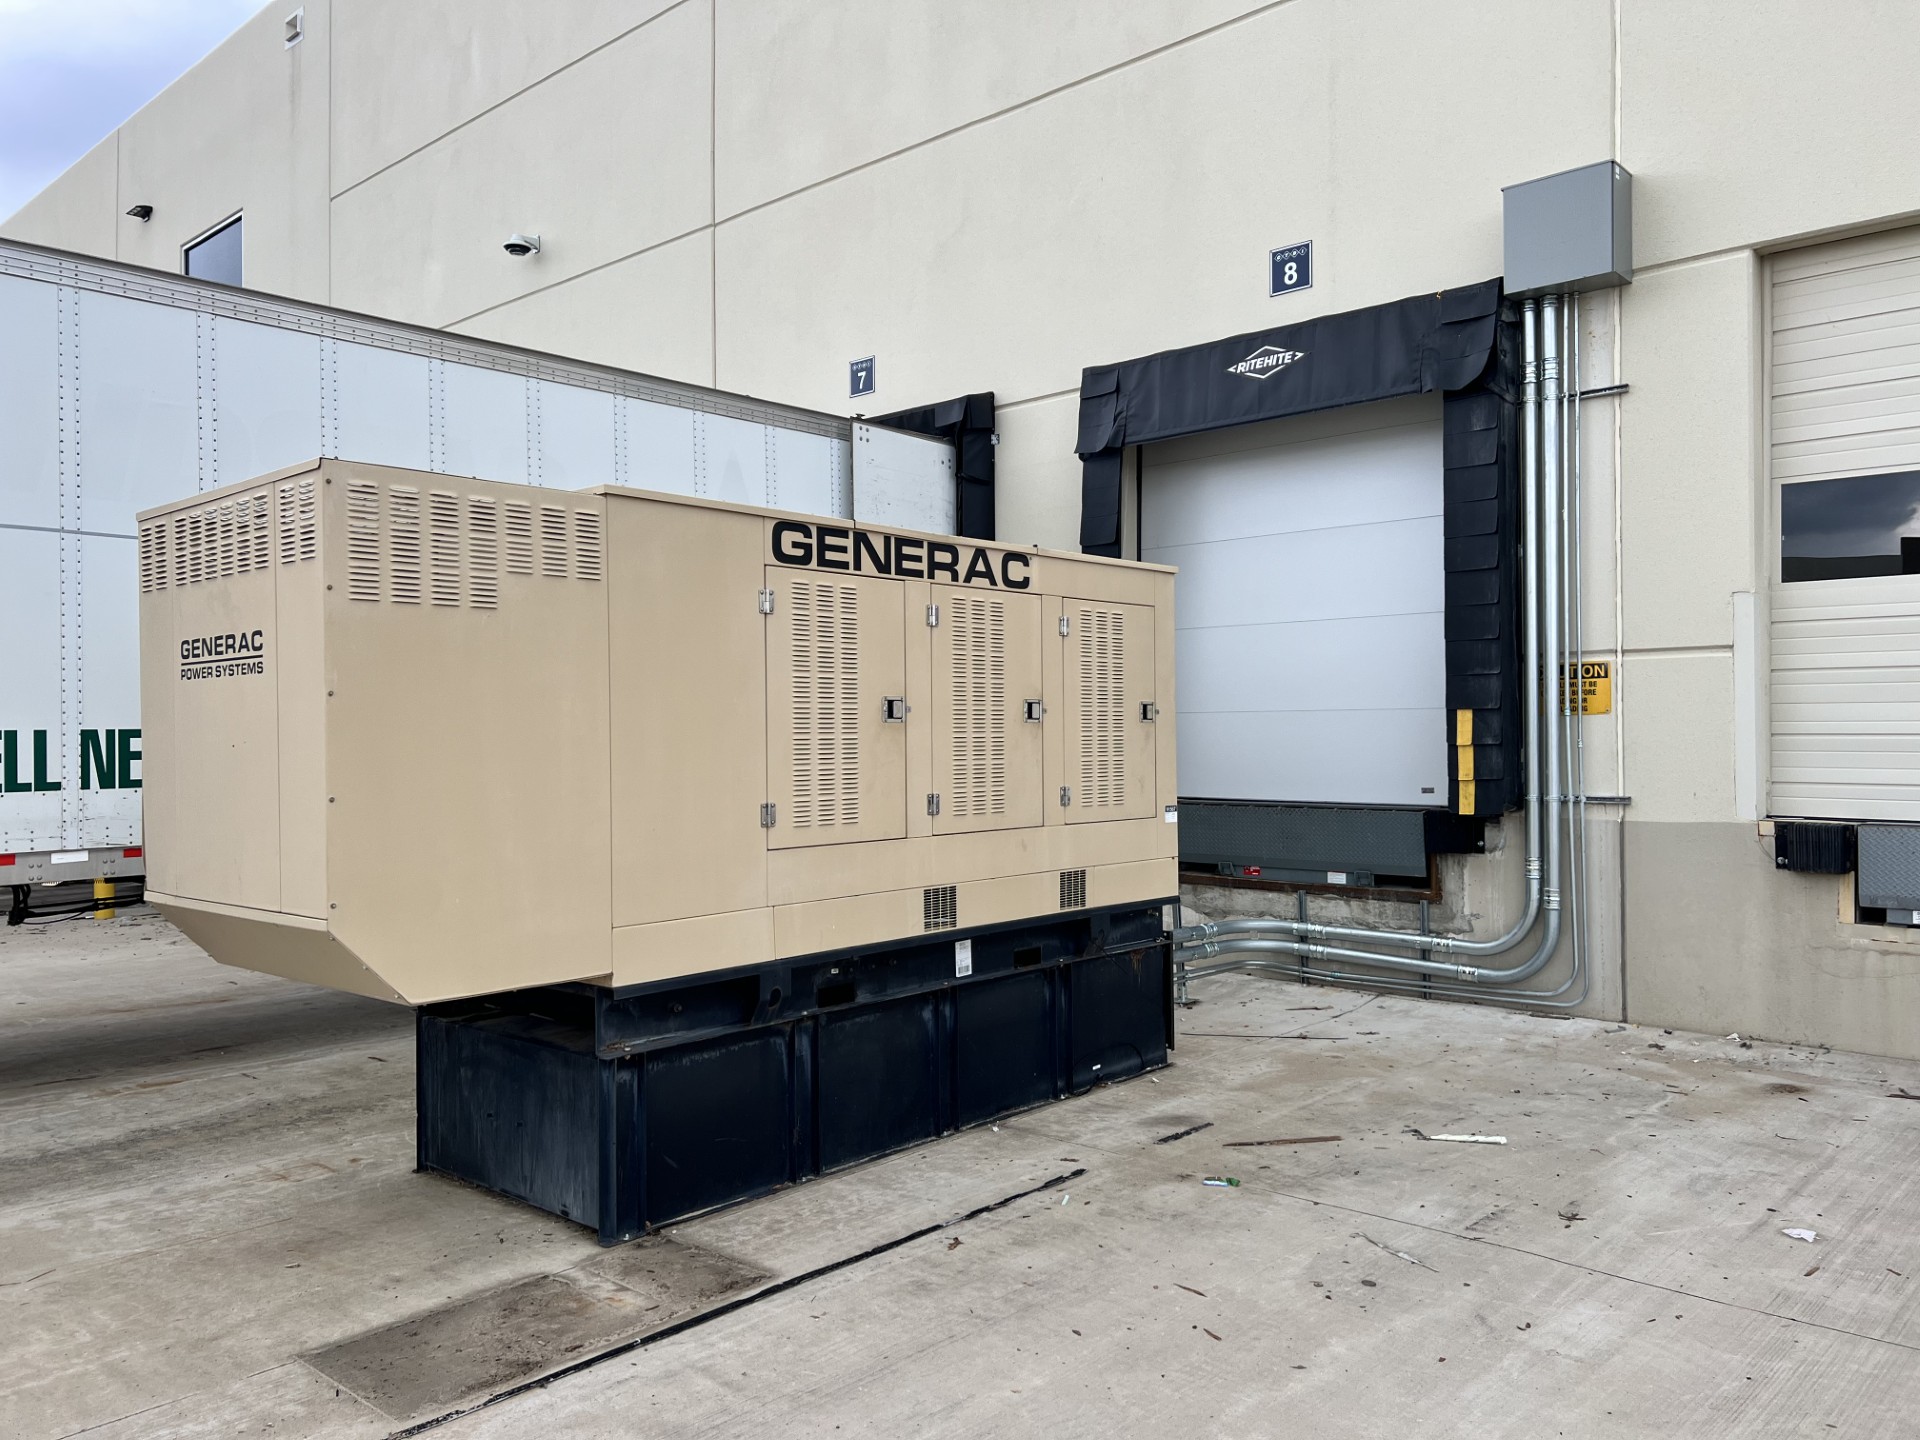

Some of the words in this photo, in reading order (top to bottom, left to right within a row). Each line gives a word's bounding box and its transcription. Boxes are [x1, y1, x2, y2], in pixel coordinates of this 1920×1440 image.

[1284, 262, 1298, 285] 8
[1236, 351, 1295, 374] RITEHITE
[857, 371, 867, 390] 7
[771, 520, 1030, 590] GENERAC
[180, 629, 264, 660] GENERAC
[180, 666, 213, 681] POWER
[215, 661, 264, 678] SYSTEMS
[1588, 680, 1598, 688] BE
[0, 729, 62, 794] LL
